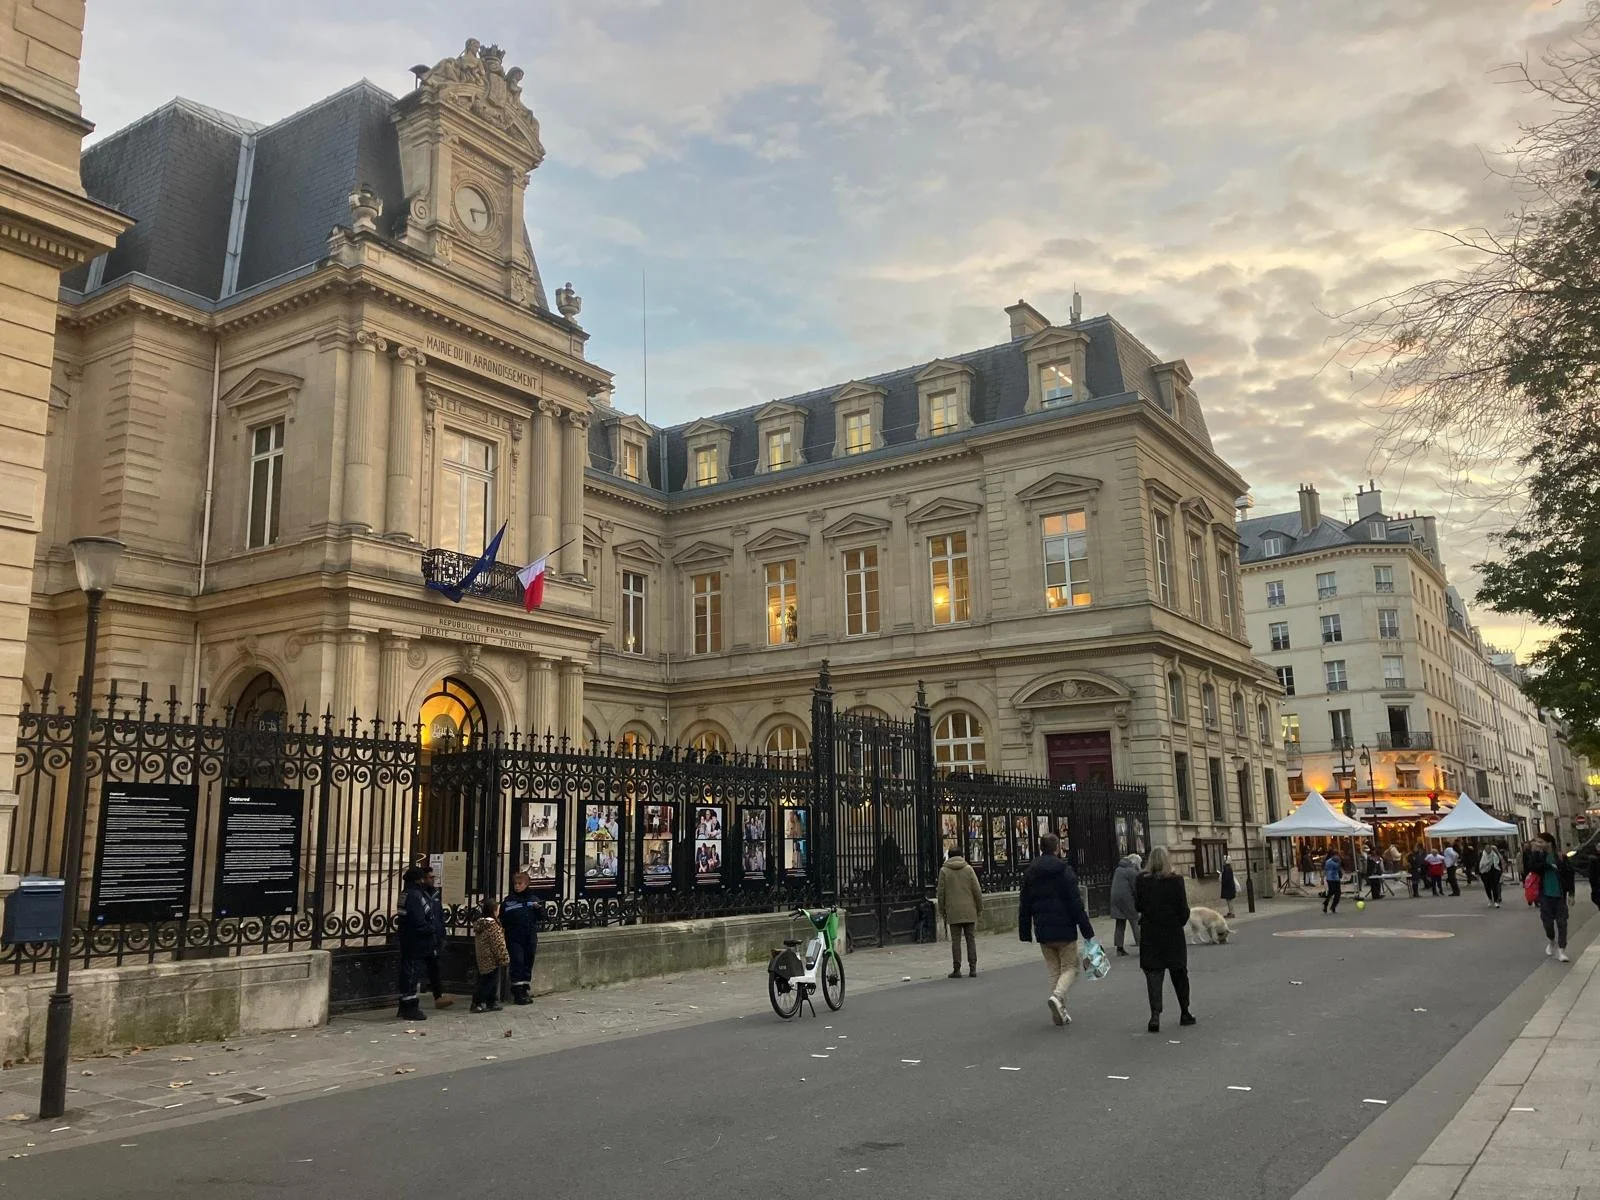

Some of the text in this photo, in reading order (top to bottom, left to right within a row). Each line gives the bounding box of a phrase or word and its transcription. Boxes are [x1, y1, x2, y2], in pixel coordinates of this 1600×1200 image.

[426, 336, 538, 390] MAIRIE DU III ARRONDISSEMENT
[486, 626, 523, 639] FRANÇAISE
